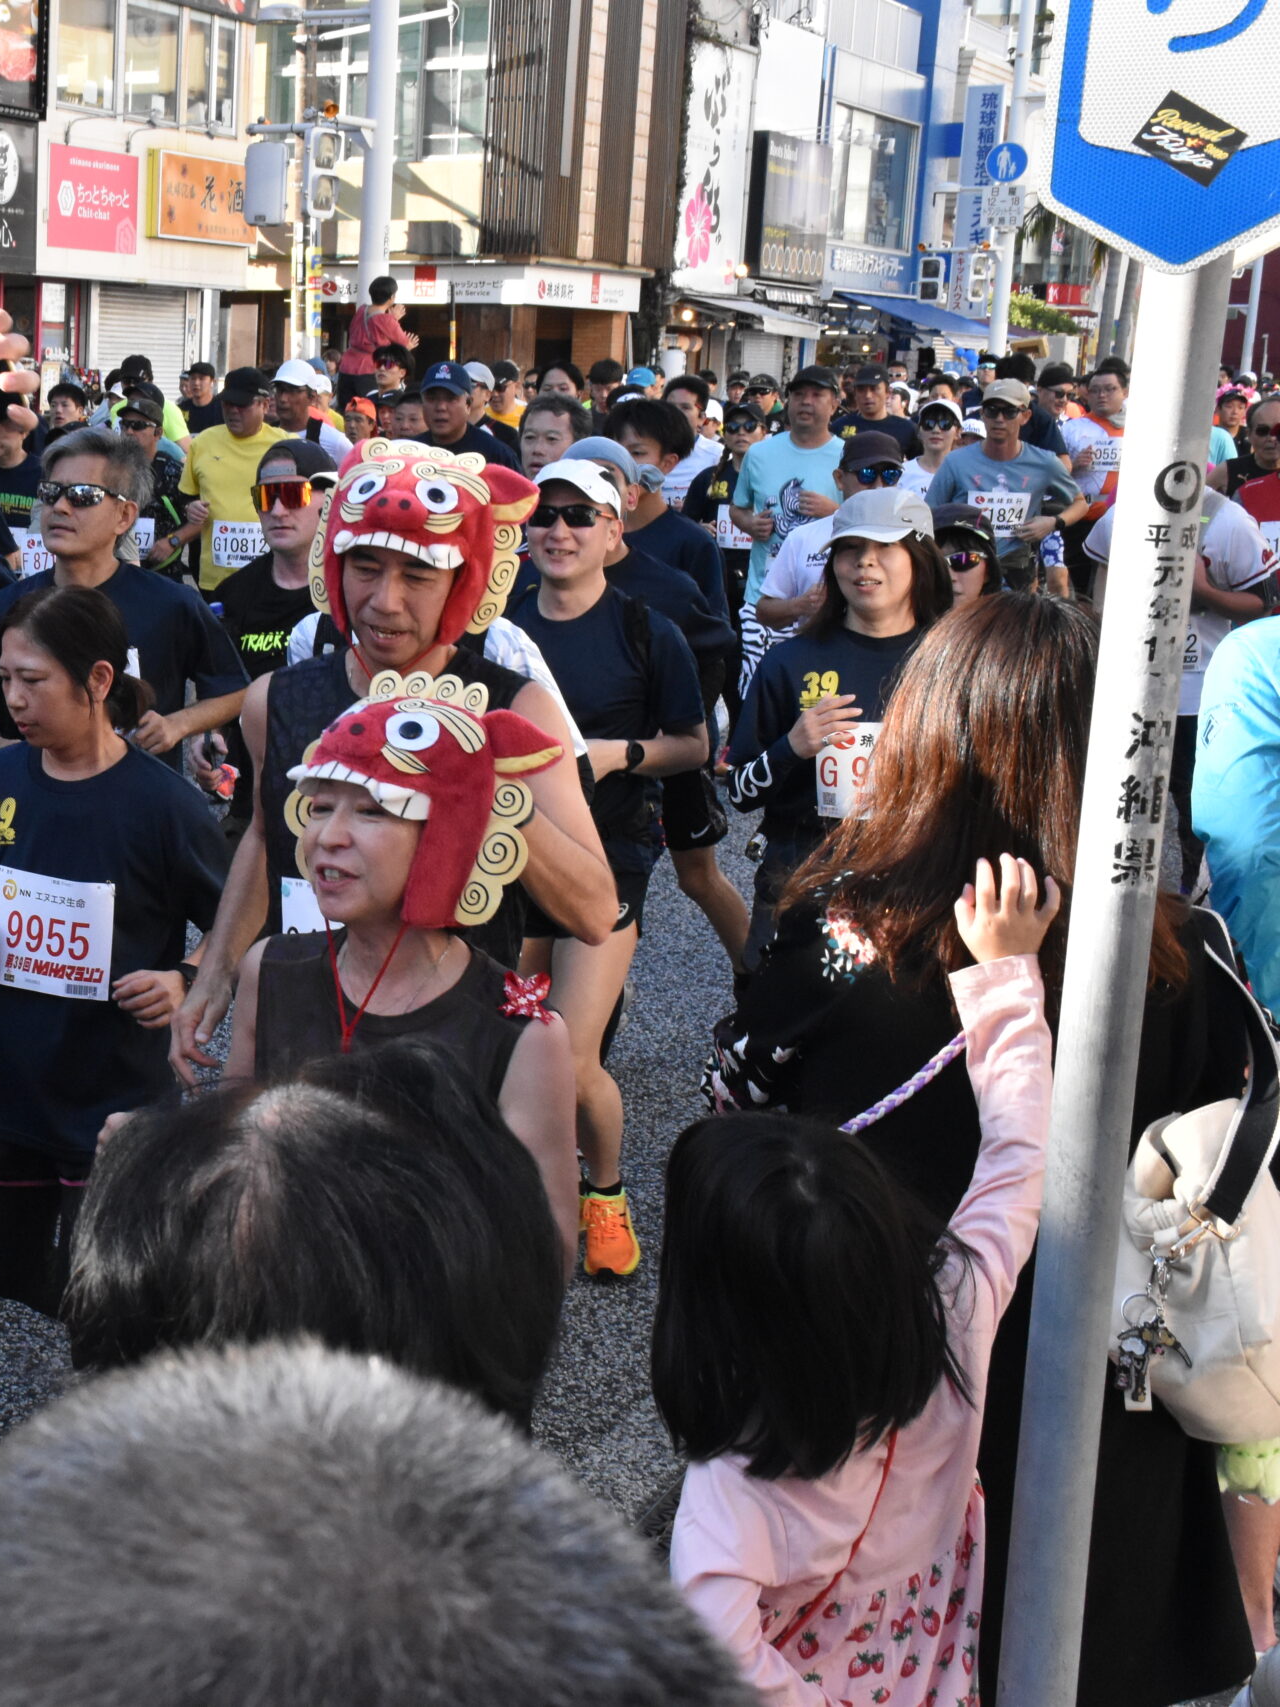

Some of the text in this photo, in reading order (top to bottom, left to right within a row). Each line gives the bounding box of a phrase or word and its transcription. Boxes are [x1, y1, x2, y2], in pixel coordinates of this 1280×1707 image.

[1149, 108, 1236, 143] Revival
[77, 183, 130, 209] ちっとちゃっと
[465, 289, 491, 297] Service
[1144, 523, 1197, 550] 平成
[240, 630, 285, 653] TRACK
[801, 670, 840, 699] 39
[820, 756, 838, 787] G
[19, 888, 32, 898] NN
[6, 910, 90, 961] 9955
[32, 958, 105, 984] NAHAマラソン
